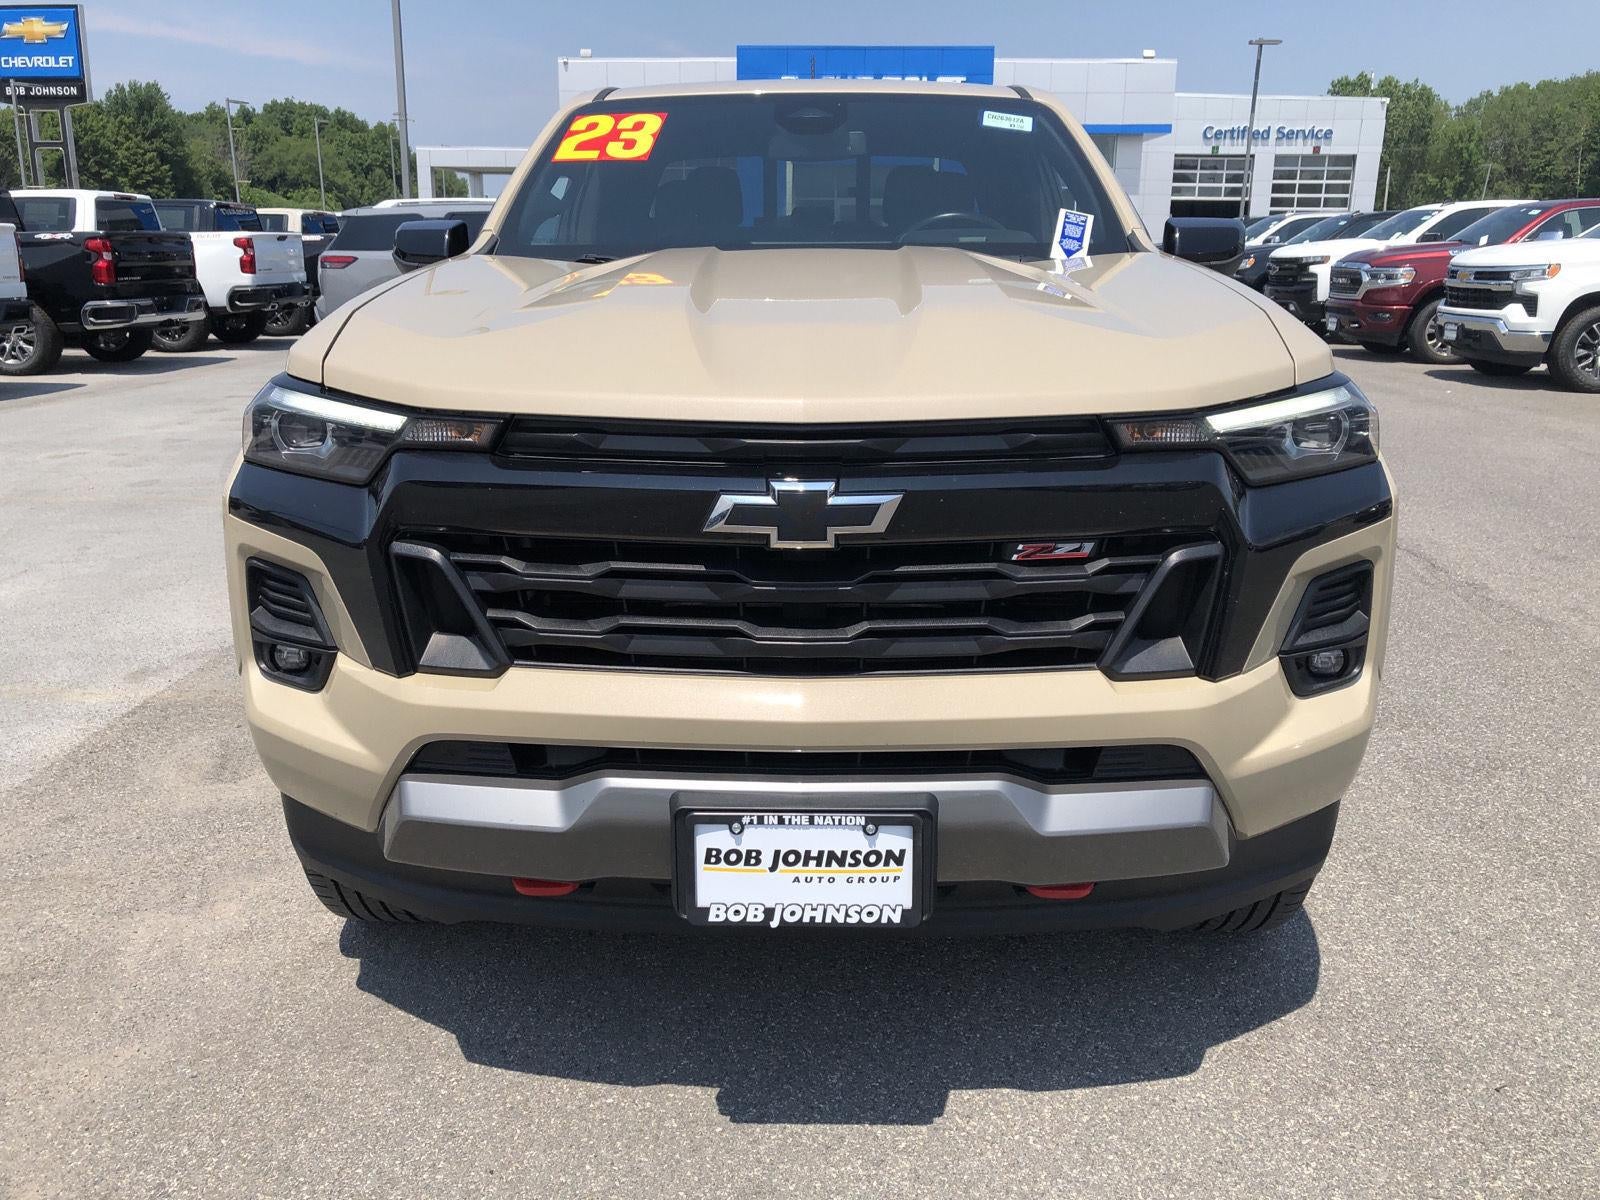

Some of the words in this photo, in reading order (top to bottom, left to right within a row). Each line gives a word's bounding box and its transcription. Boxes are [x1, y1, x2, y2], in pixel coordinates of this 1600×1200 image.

[1, 56, 74, 68] CHEVROLET
[30, 86, 77, 95] JOHNSON
[553, 113, 662, 160] 23
[1202, 125, 1271, 140] Certifed
[1275, 125, 1334, 141] Service
[1012, 542, 1095, 560] Z71
[742, 815, 758, 825] #1
[763, 815, 778, 825] IN
[782, 815, 811, 826] THE
[814, 816, 866, 826] NATION
[703, 847, 762, 867] BOB
[768, 848, 906, 872] JOHNSON
[792, 876, 836, 884] AUTO
[846, 875, 901, 884] GROUP
[707, 903, 765, 923] BOB
[769, 903, 904, 929] JOHNSON
